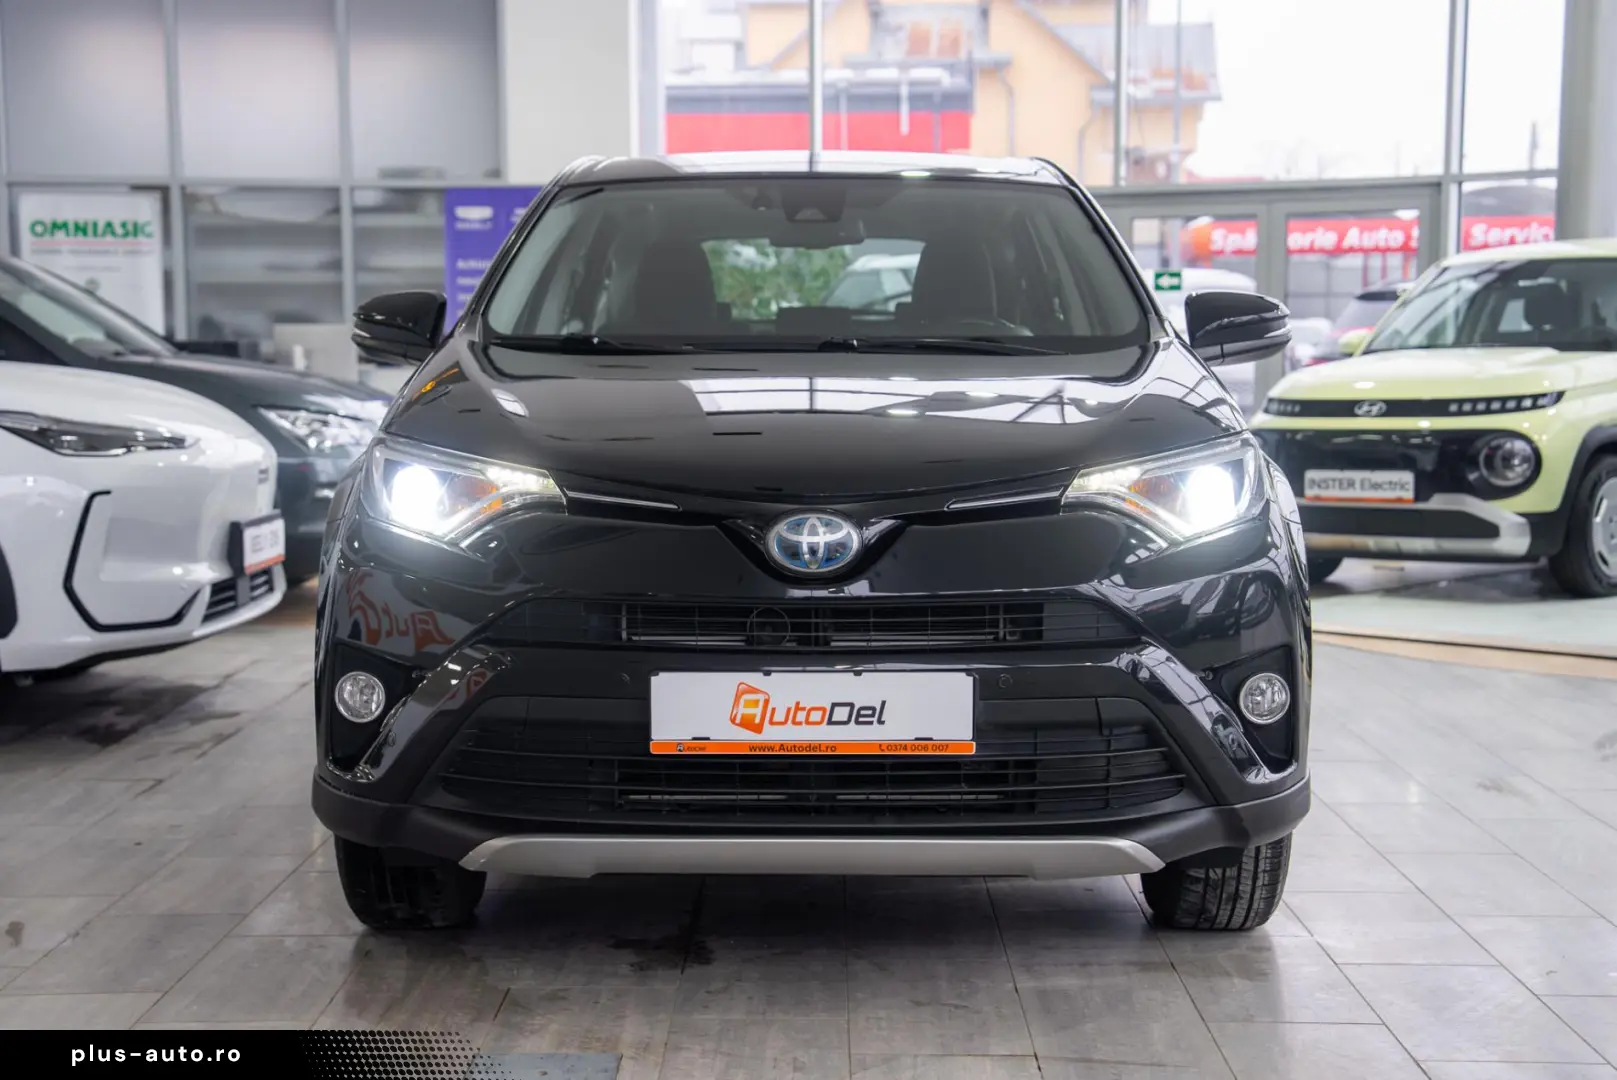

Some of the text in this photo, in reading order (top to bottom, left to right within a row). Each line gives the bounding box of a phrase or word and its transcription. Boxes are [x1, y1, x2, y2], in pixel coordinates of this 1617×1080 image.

[1341, 225, 1406, 250] Auto
[1307, 477, 1410, 492] INSTER Electric
[733, 689, 887, 729] AutoDel
[748, 743, 837, 753] www.Autodel.ro
[886, 743, 949, 752] 0374 006 007
